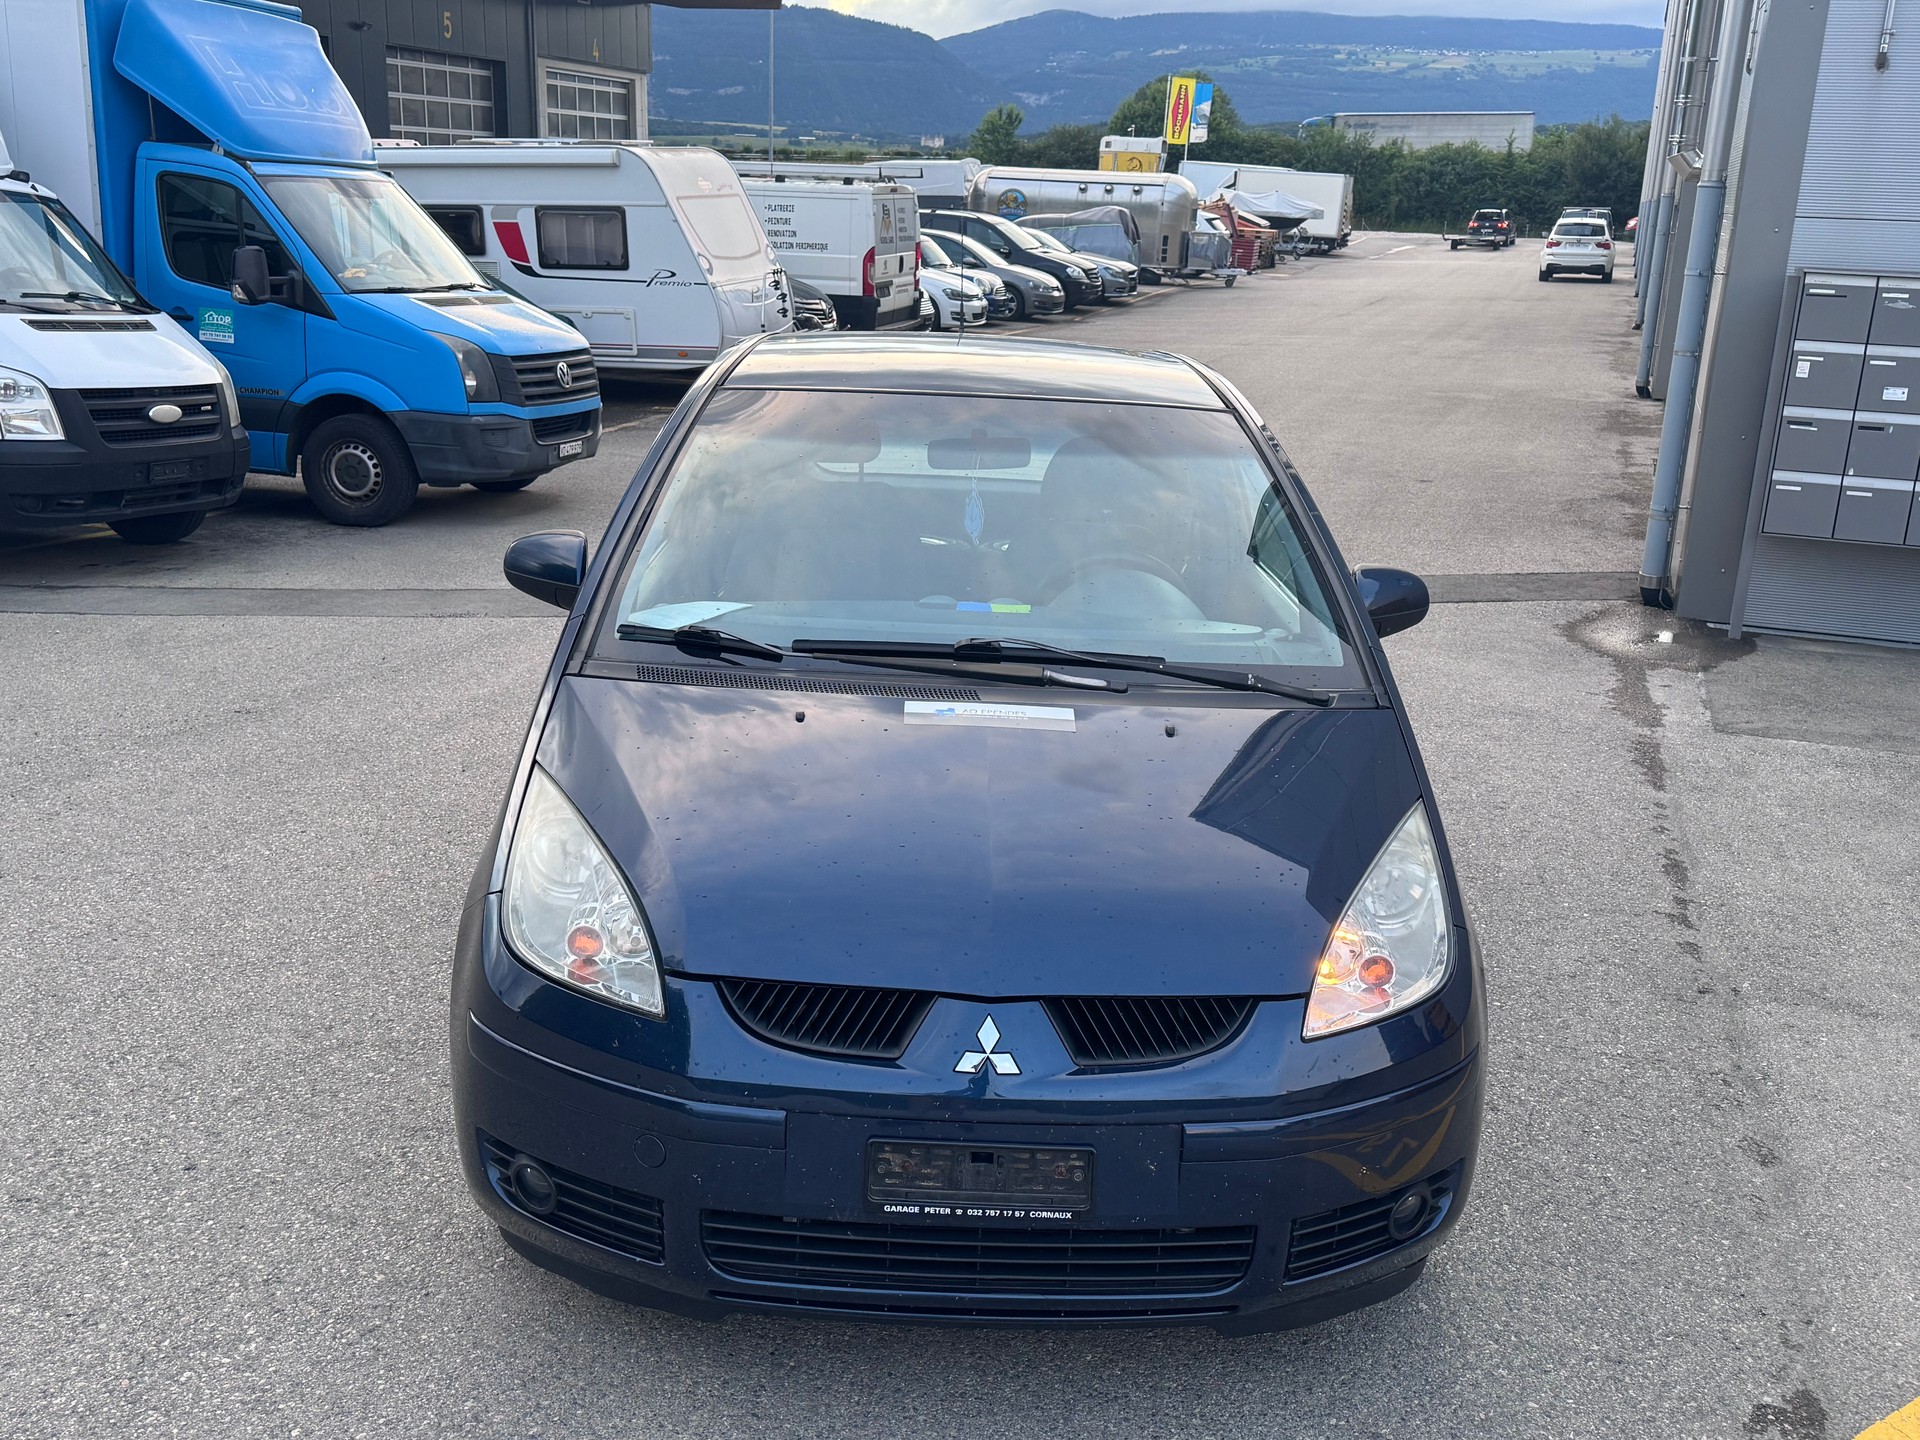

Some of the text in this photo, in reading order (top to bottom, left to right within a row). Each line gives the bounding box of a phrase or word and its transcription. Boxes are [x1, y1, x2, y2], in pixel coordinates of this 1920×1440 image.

[443, 11, 453, 39] 5
[592, 38, 600, 62] 4
[767, 204, 795, 212] PLATRERIE
[767, 217, 792, 225] PEINTURE
[767, 229, 797, 237] RENOVATION
[645, 268, 693, 288] Premio
[239, 386, 280, 397] CHAMPION
[883, 1204, 1073, 1220] GARAGE PETER 032 757 17 57 CORNAUX
